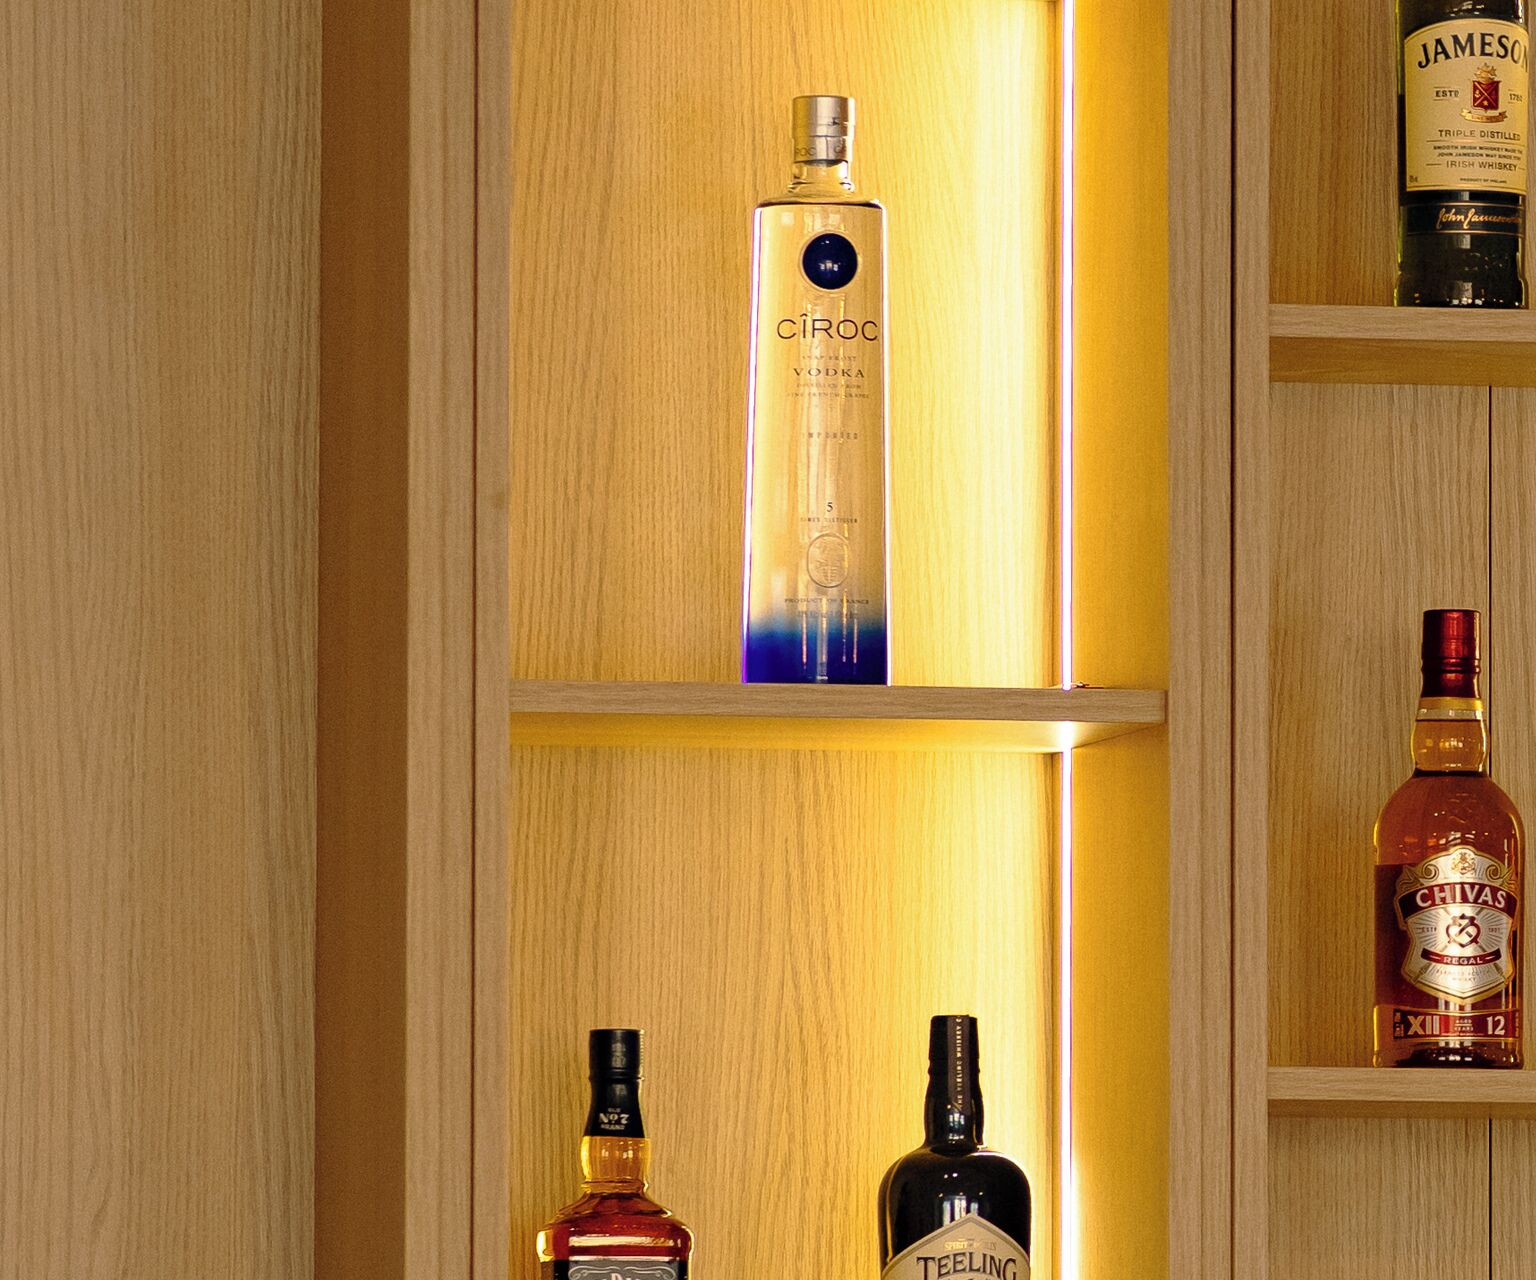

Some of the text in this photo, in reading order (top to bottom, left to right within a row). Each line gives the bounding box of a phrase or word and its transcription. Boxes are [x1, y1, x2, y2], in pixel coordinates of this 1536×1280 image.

[1438, 129, 1521, 142] TRIPLE DISTILLED
[1445, 160, 1518, 173] IRISH WHISKEY
[777, 312, 879, 342] CÎROC
[793, 367, 866, 379] VODKA
[1415, 883, 1508, 910] CHIVAS
[1443, 955, 1485, 965] REGAL
[1406, 1014, 1441, 1036] XII
[1485, 1014, 1506, 1036] 12
